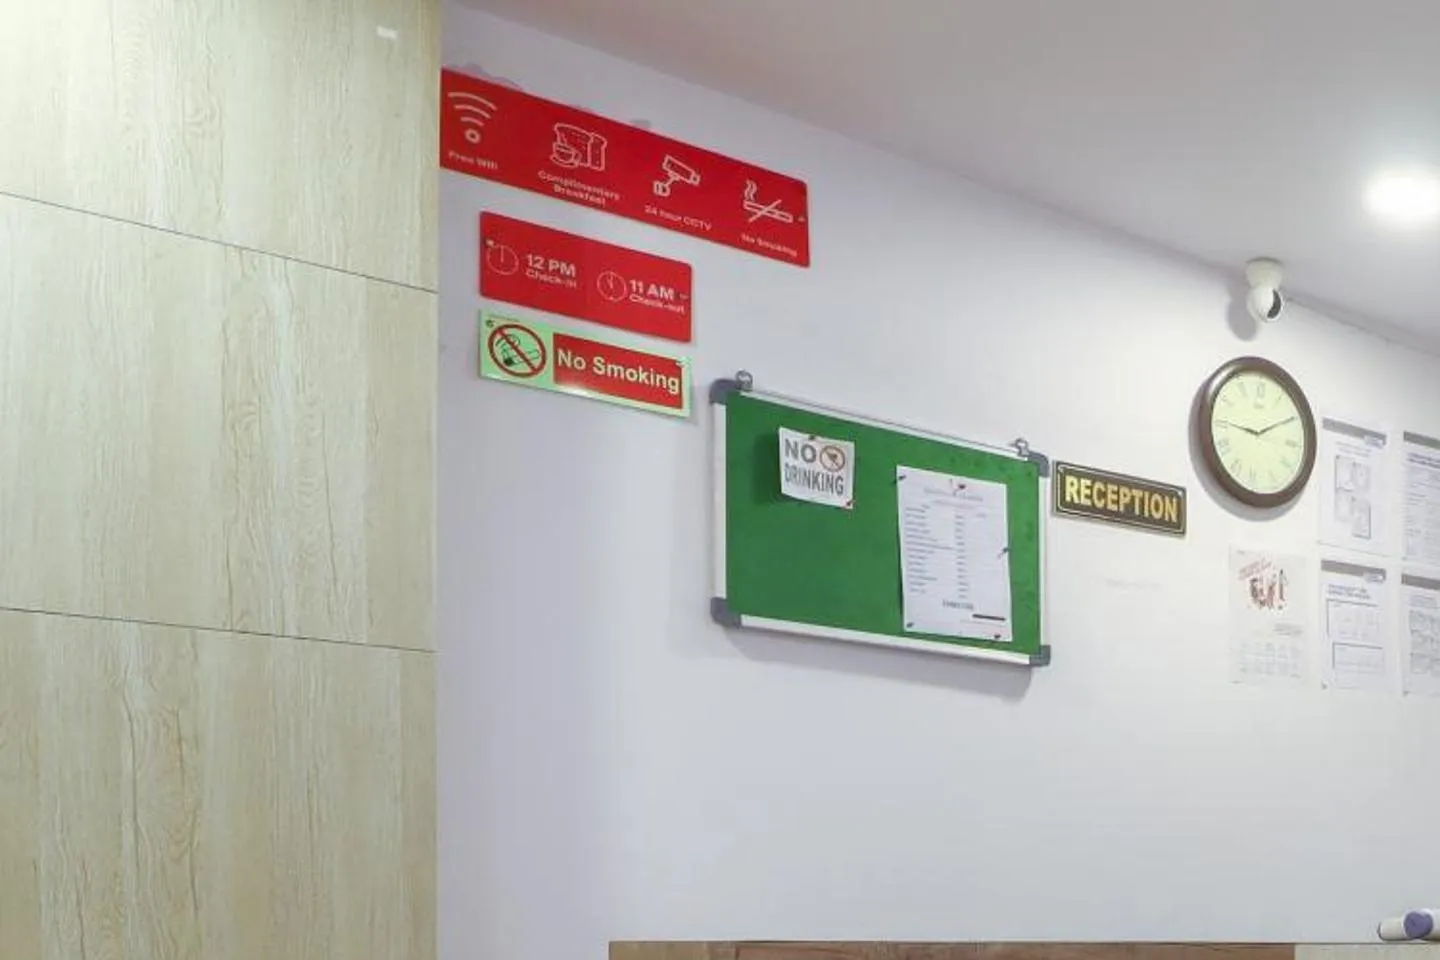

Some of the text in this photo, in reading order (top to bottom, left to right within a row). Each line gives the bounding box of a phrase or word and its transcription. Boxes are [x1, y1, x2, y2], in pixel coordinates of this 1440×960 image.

[683, 215, 712, 231] CCTV
[525, 267, 578, 289] Check-in
[526, 253, 577, 278] 12 PM
[629, 279, 675, 301] 11 AM
[629, 293, 685, 314] Check-out
[557, 349, 680, 394] No Smoking
[784, 438, 817, 463] NO
[784, 462, 844, 496] DRINKING
[1064, 475, 1179, 523] RECEPTION
